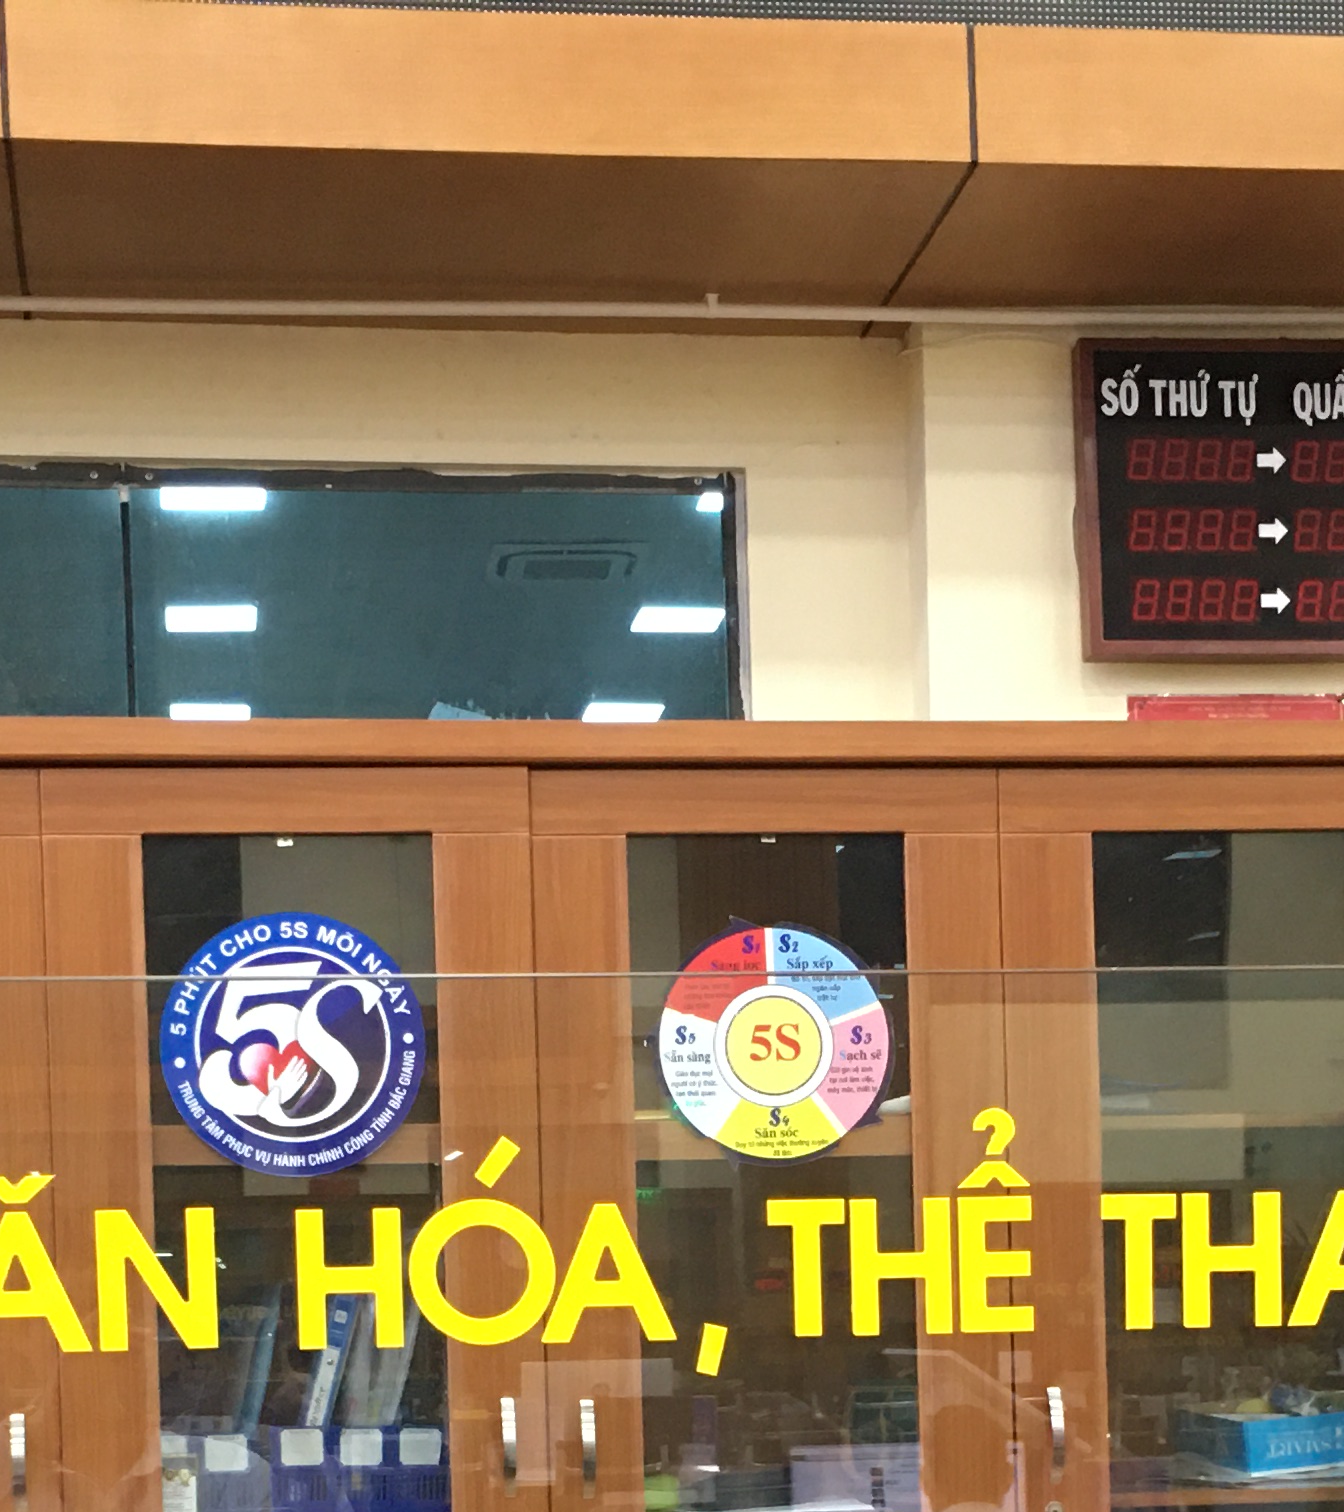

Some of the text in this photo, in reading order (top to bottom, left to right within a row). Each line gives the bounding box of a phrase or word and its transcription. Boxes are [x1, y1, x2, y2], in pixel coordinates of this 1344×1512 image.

[1101, 364, 1141, 416] SỐ
[1150, 369, 1210, 418] THỨ
[1218, 374, 1259, 426] TỰ
[219, 925, 272, 957] CHO
[279, 921, 308, 939] 5S
[787, 955, 834, 971] Sắp xếp
[174, 952, 217, 1015] PHÚT
[361, 953, 411, 1014] NGÀY
[169, 1022, 187, 1036] 5
[750, 1023, 801, 1063] 5S
[687, 1051, 711, 1065] sàng
[840, 1049, 867, 1064] Sạch
[178, 1080, 205, 1119] TRUNG
[201, 1115, 225, 1140] TÂM
[221, 1134, 254, 1157] PHỤC
[256, 1149, 272, 1166] VỤ
[273, 1152, 306, 1167] HÀNH
[308, 1147, 345, 1166] CHÍNH
[343, 1129, 375, 1154] CÔNG
[398, 1050, 416, 1086] GIANG
[780, 1126, 799, 1138] sóc
[297, 1135, 728, 1378] HÓA,
[765, 1106, 1037, 1340] THỂ
